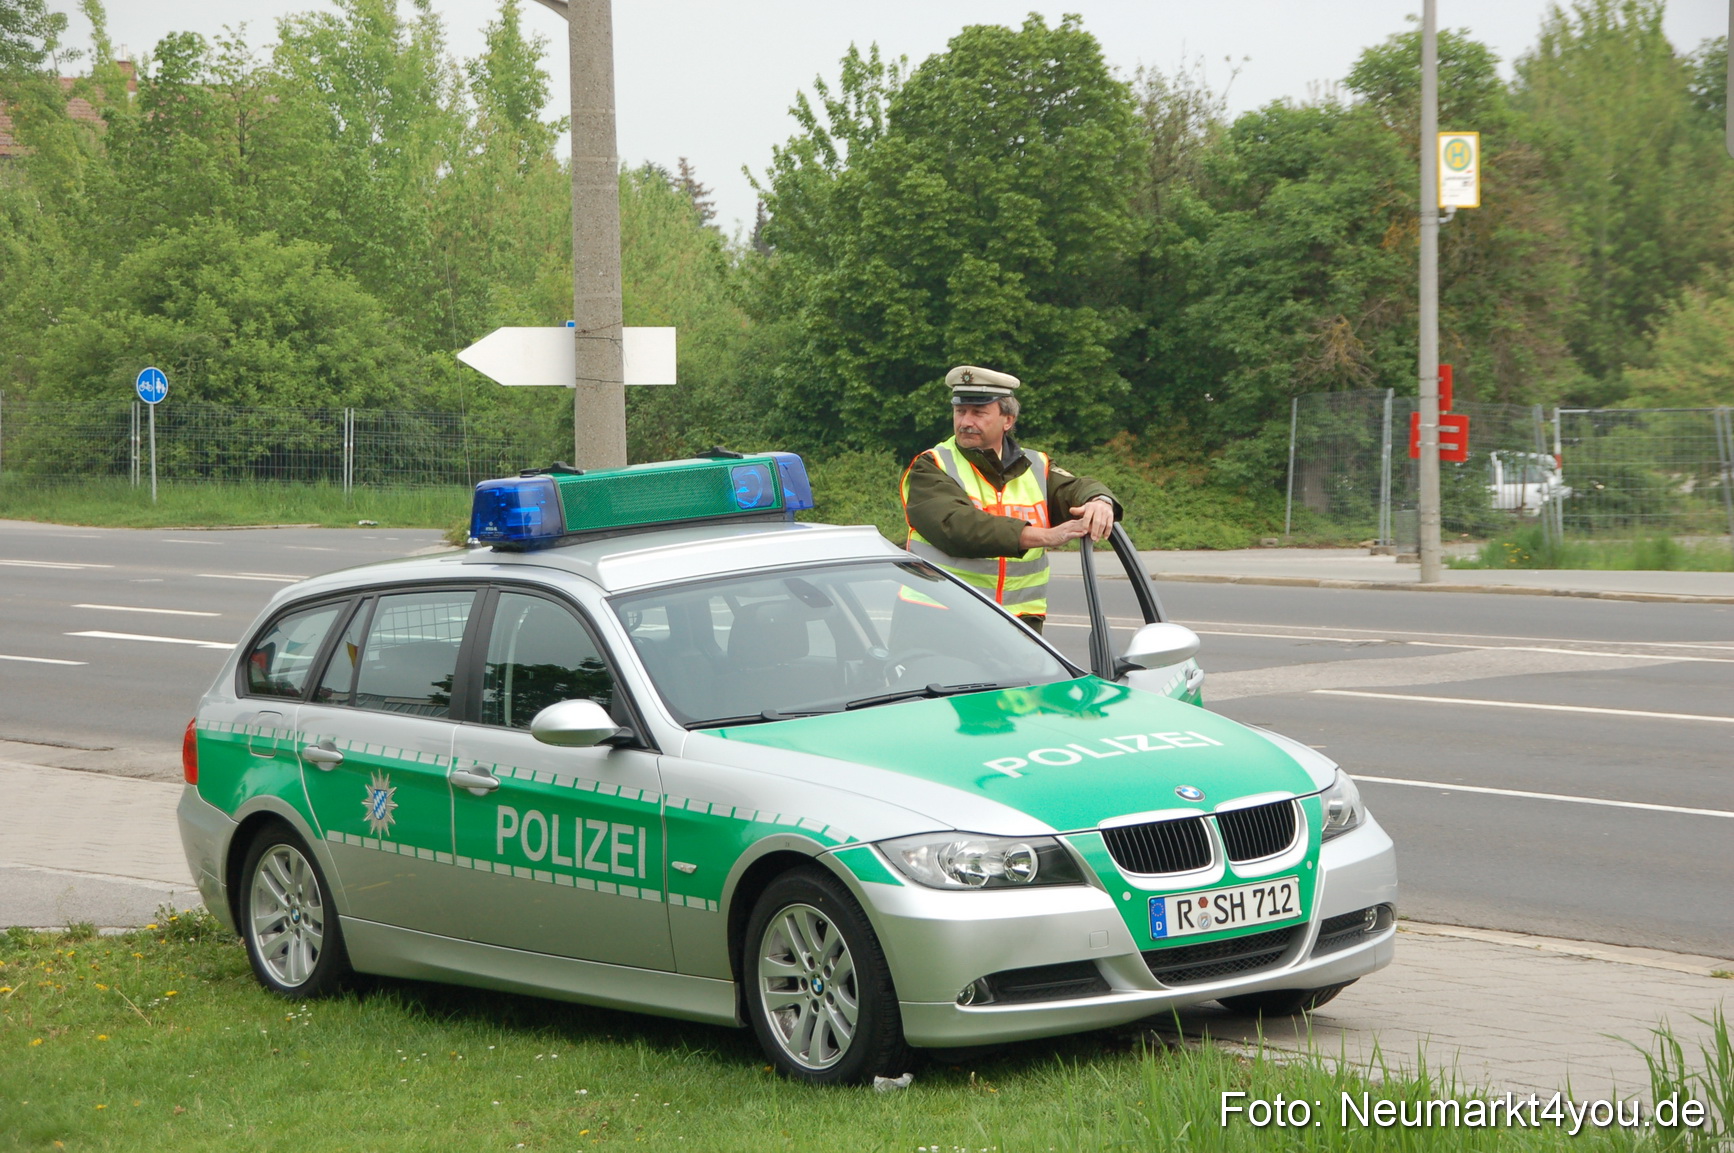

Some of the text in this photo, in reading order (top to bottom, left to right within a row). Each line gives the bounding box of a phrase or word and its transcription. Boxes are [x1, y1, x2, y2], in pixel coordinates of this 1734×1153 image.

[1451, 146, 1465, 164] H
[983, 731, 1224, 779] POLIZEI
[496, 804, 646, 879] POLIZEI
[1155, 921, 1163, 931] D
[1177, 883, 1293, 930] R SH 712
